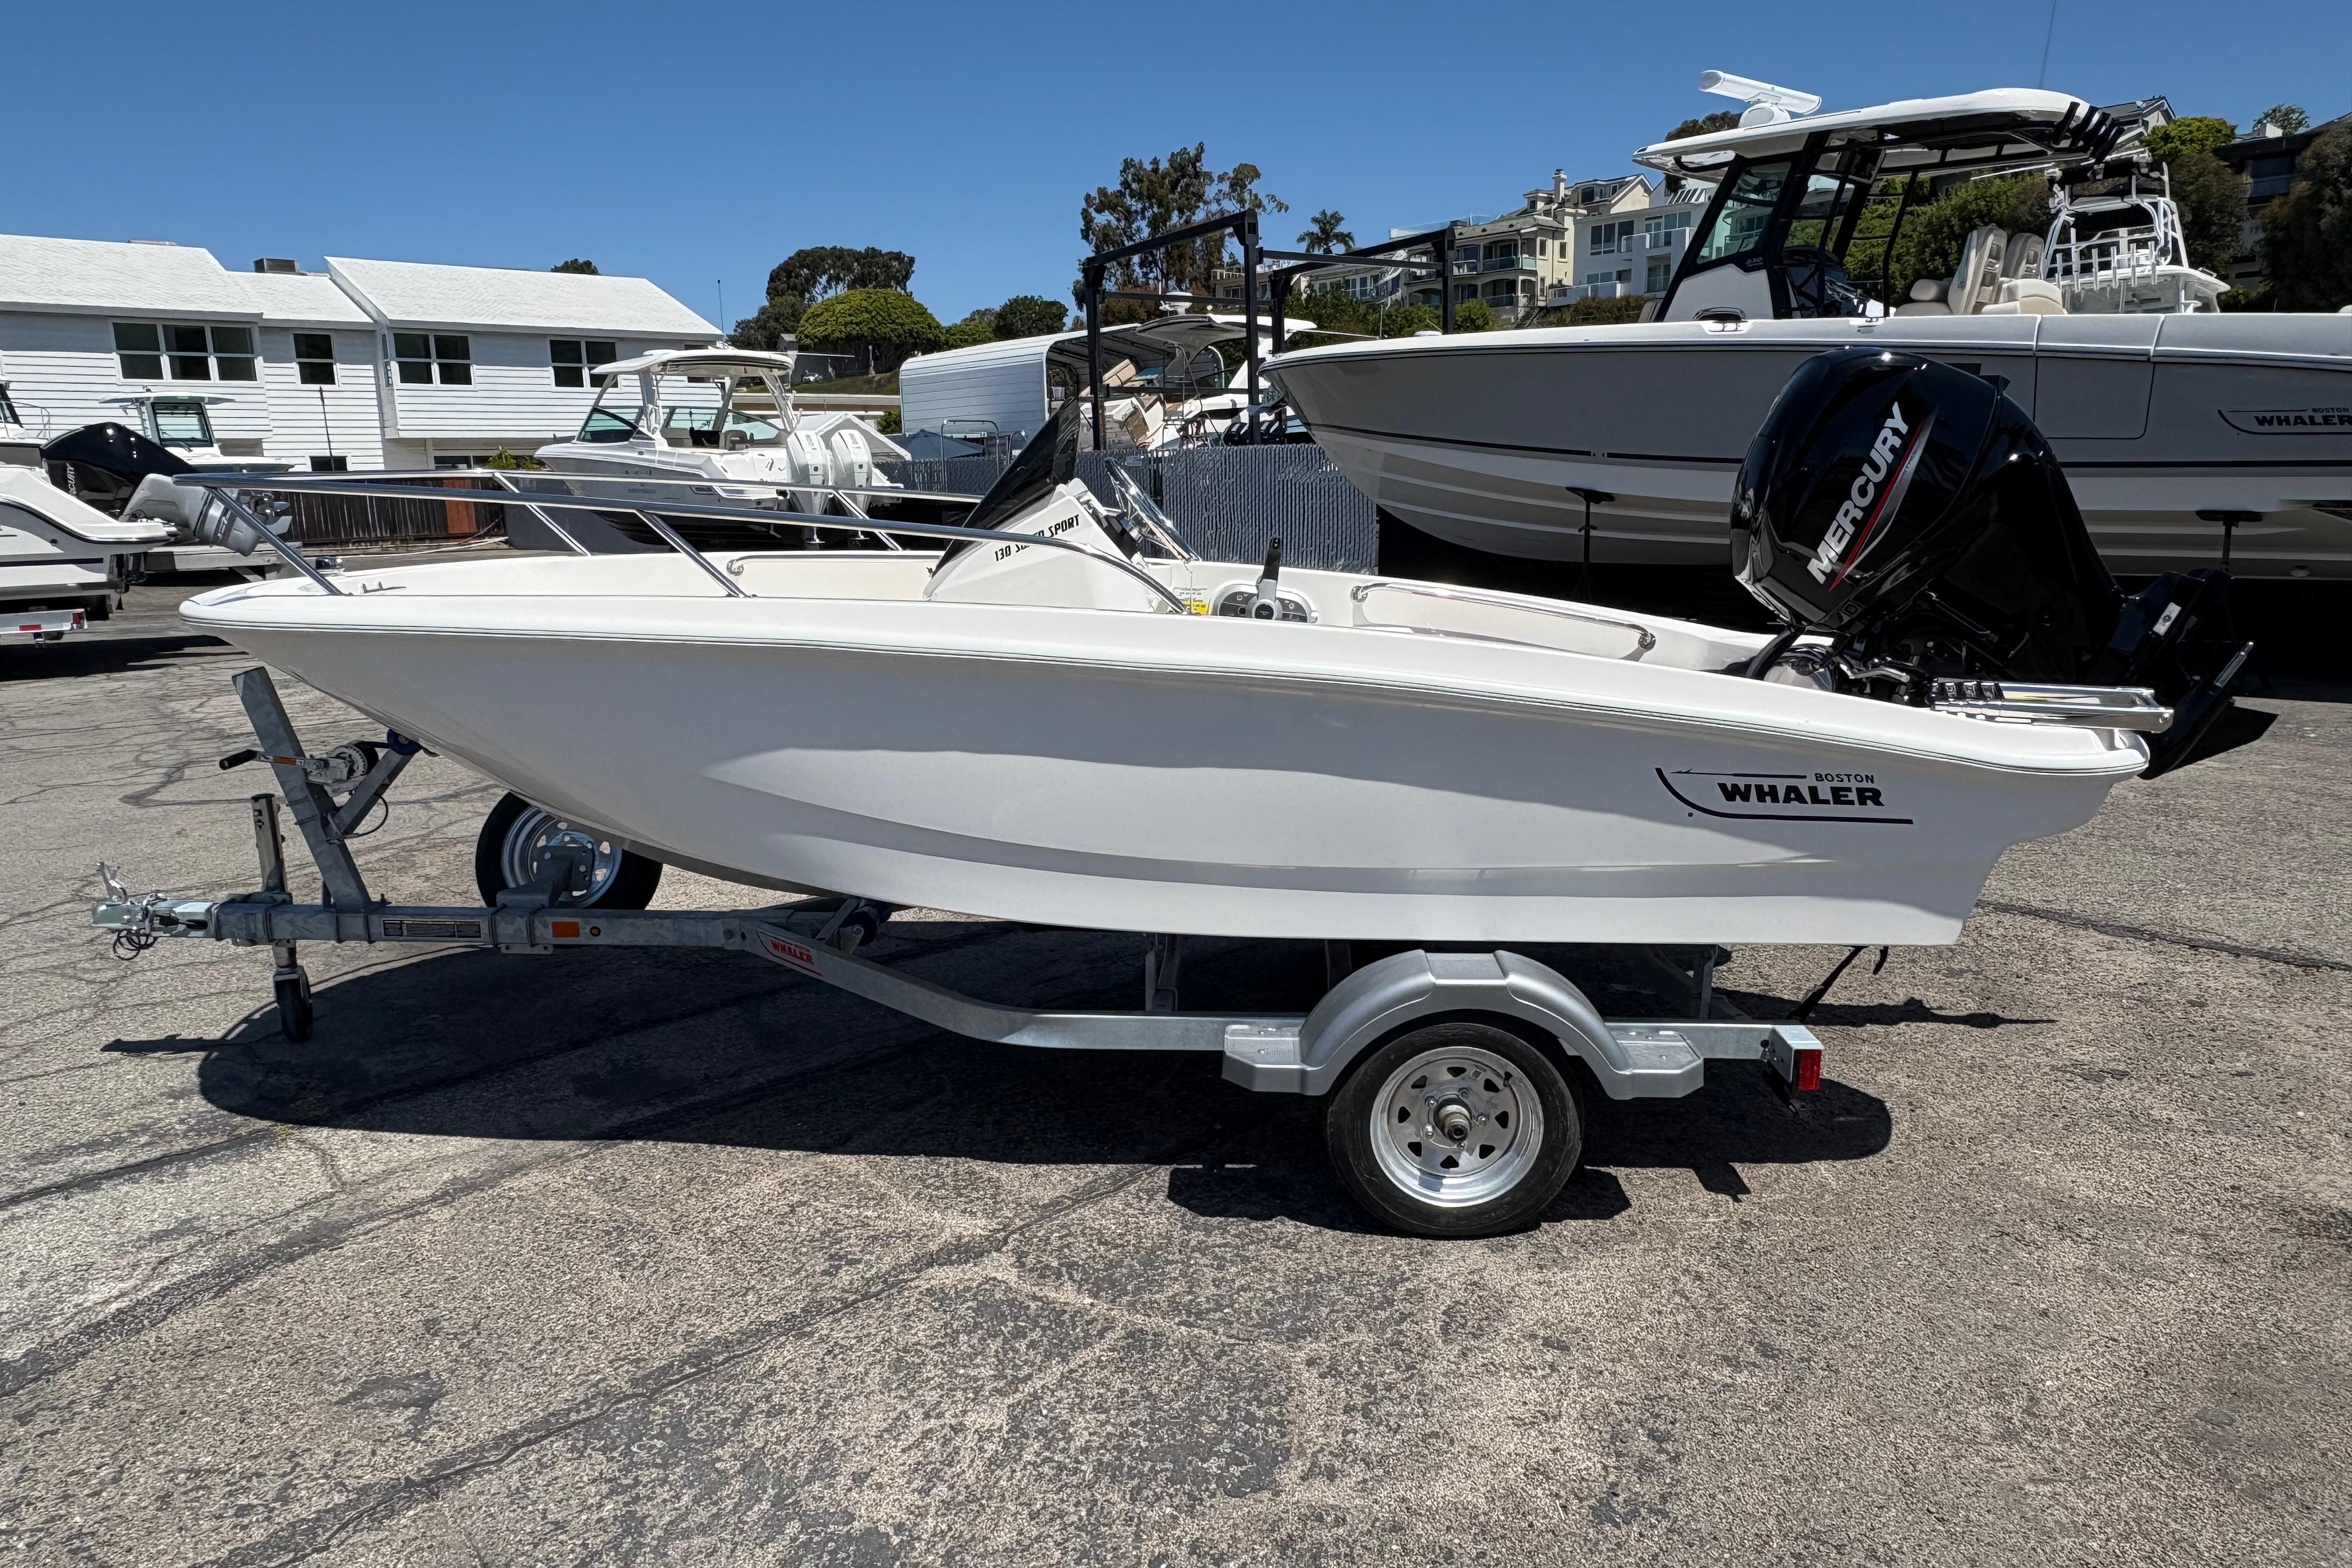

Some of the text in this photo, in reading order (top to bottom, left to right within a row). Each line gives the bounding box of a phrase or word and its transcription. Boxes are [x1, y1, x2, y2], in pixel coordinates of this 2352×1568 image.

[2254, 414, 2352, 426] WHALER
[1807, 401, 1909, 584] MERCURY
[994, 514, 1079, 562] 130 SPORT
[1814, 772, 1875, 784] BOSTON
[1717, 782, 1885, 807] WHALER
